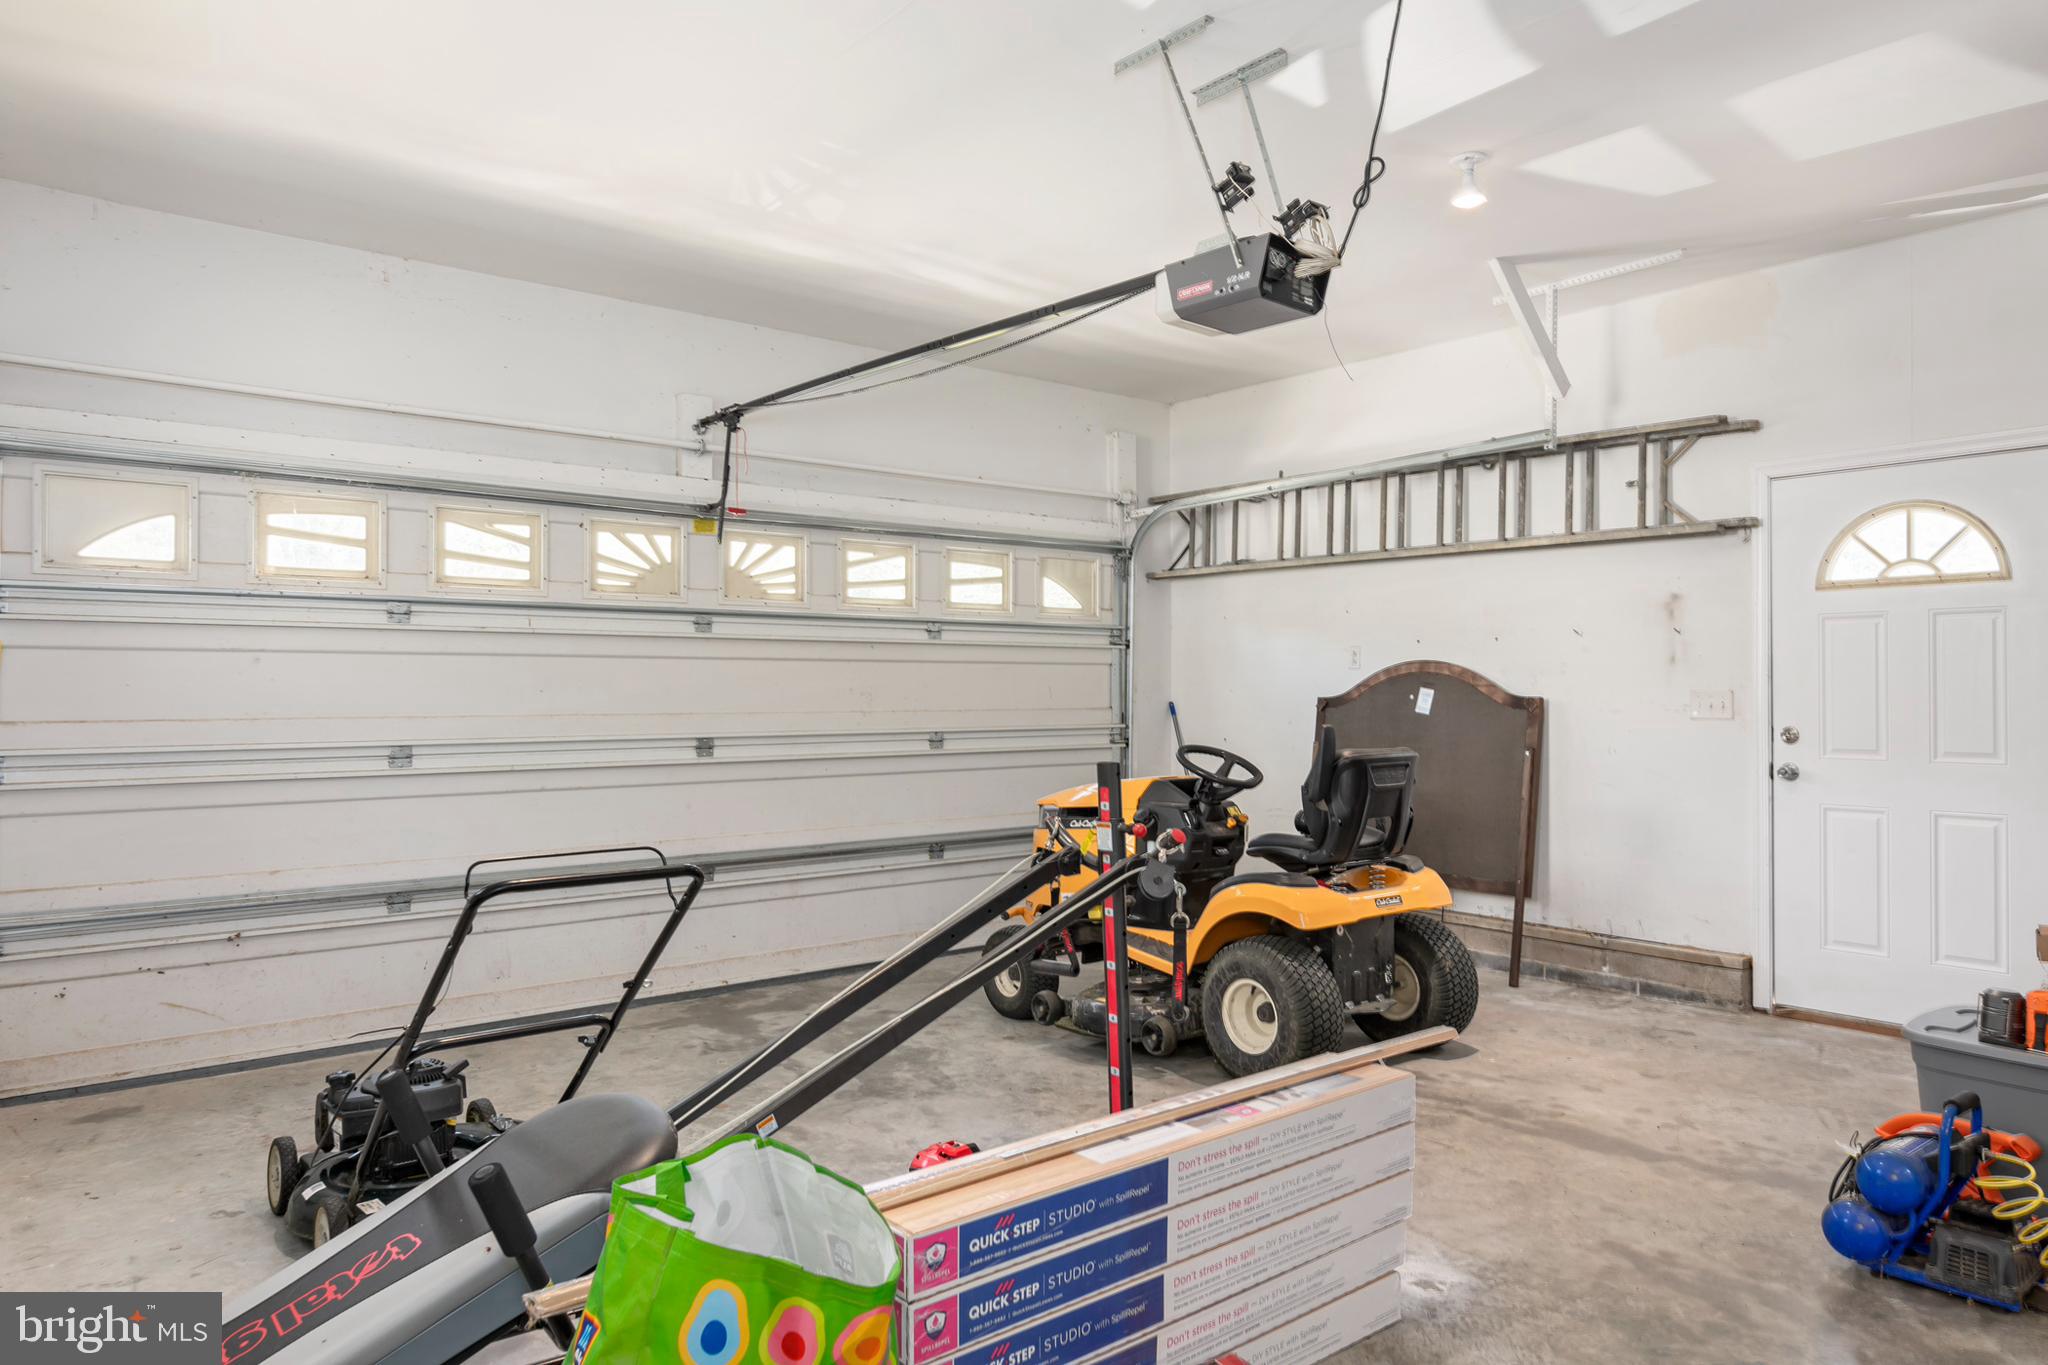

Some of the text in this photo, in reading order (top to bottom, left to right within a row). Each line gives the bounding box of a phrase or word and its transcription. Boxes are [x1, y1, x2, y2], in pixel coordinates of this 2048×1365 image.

[1178, 1155, 1201, 1172] Don't
[1203, 1149, 1227, 1164] stress
[1229, 1140, 1243, 1156] the
[1244, 1134, 1260, 1155] spill
[1281, 1125, 1301, 1140] STYLE
[1303, 1118, 1316, 1132] with
[1099, 1196, 1115, 1209] with
[1115, 1184, 1151, 1204] SpillRepel
[1177, 1213, 1200, 1231] Don't
[1202, 1206, 1226, 1223] stress
[1228, 1198, 1242, 1213] the
[1243, 1191, 1259, 1211] spill
[1281, 1177, 1301, 1191] STYLE
[1302, 1169, 1315, 1183] with
[1098, 1257, 1114, 1270] with
[1173, 1270, 1197, 1288] Don't
[1199, 1261, 1223, 1279] stress
[1224, 1252, 1238, 1268] the
[1240, 1245, 1256, 1266] spill
[1278, 1229, 1298, 1244] STYLE
[1299, 1222, 1312, 1236] with
[1094, 1317, 1110, 1331] with
[1166, 1329, 1190, 1348] Don't
[1192, 1320, 1216, 1338] stress
[1218, 1310, 1232, 1325] the
[1233, 1302, 1249, 1324] spill
[1271, 1284, 1291, 1299] STYLE
[1292, 1275, 1305, 1290] with
[1265, 1340, 1284, 1357] STYLE
[1286, 1331, 1298, 1346] with
